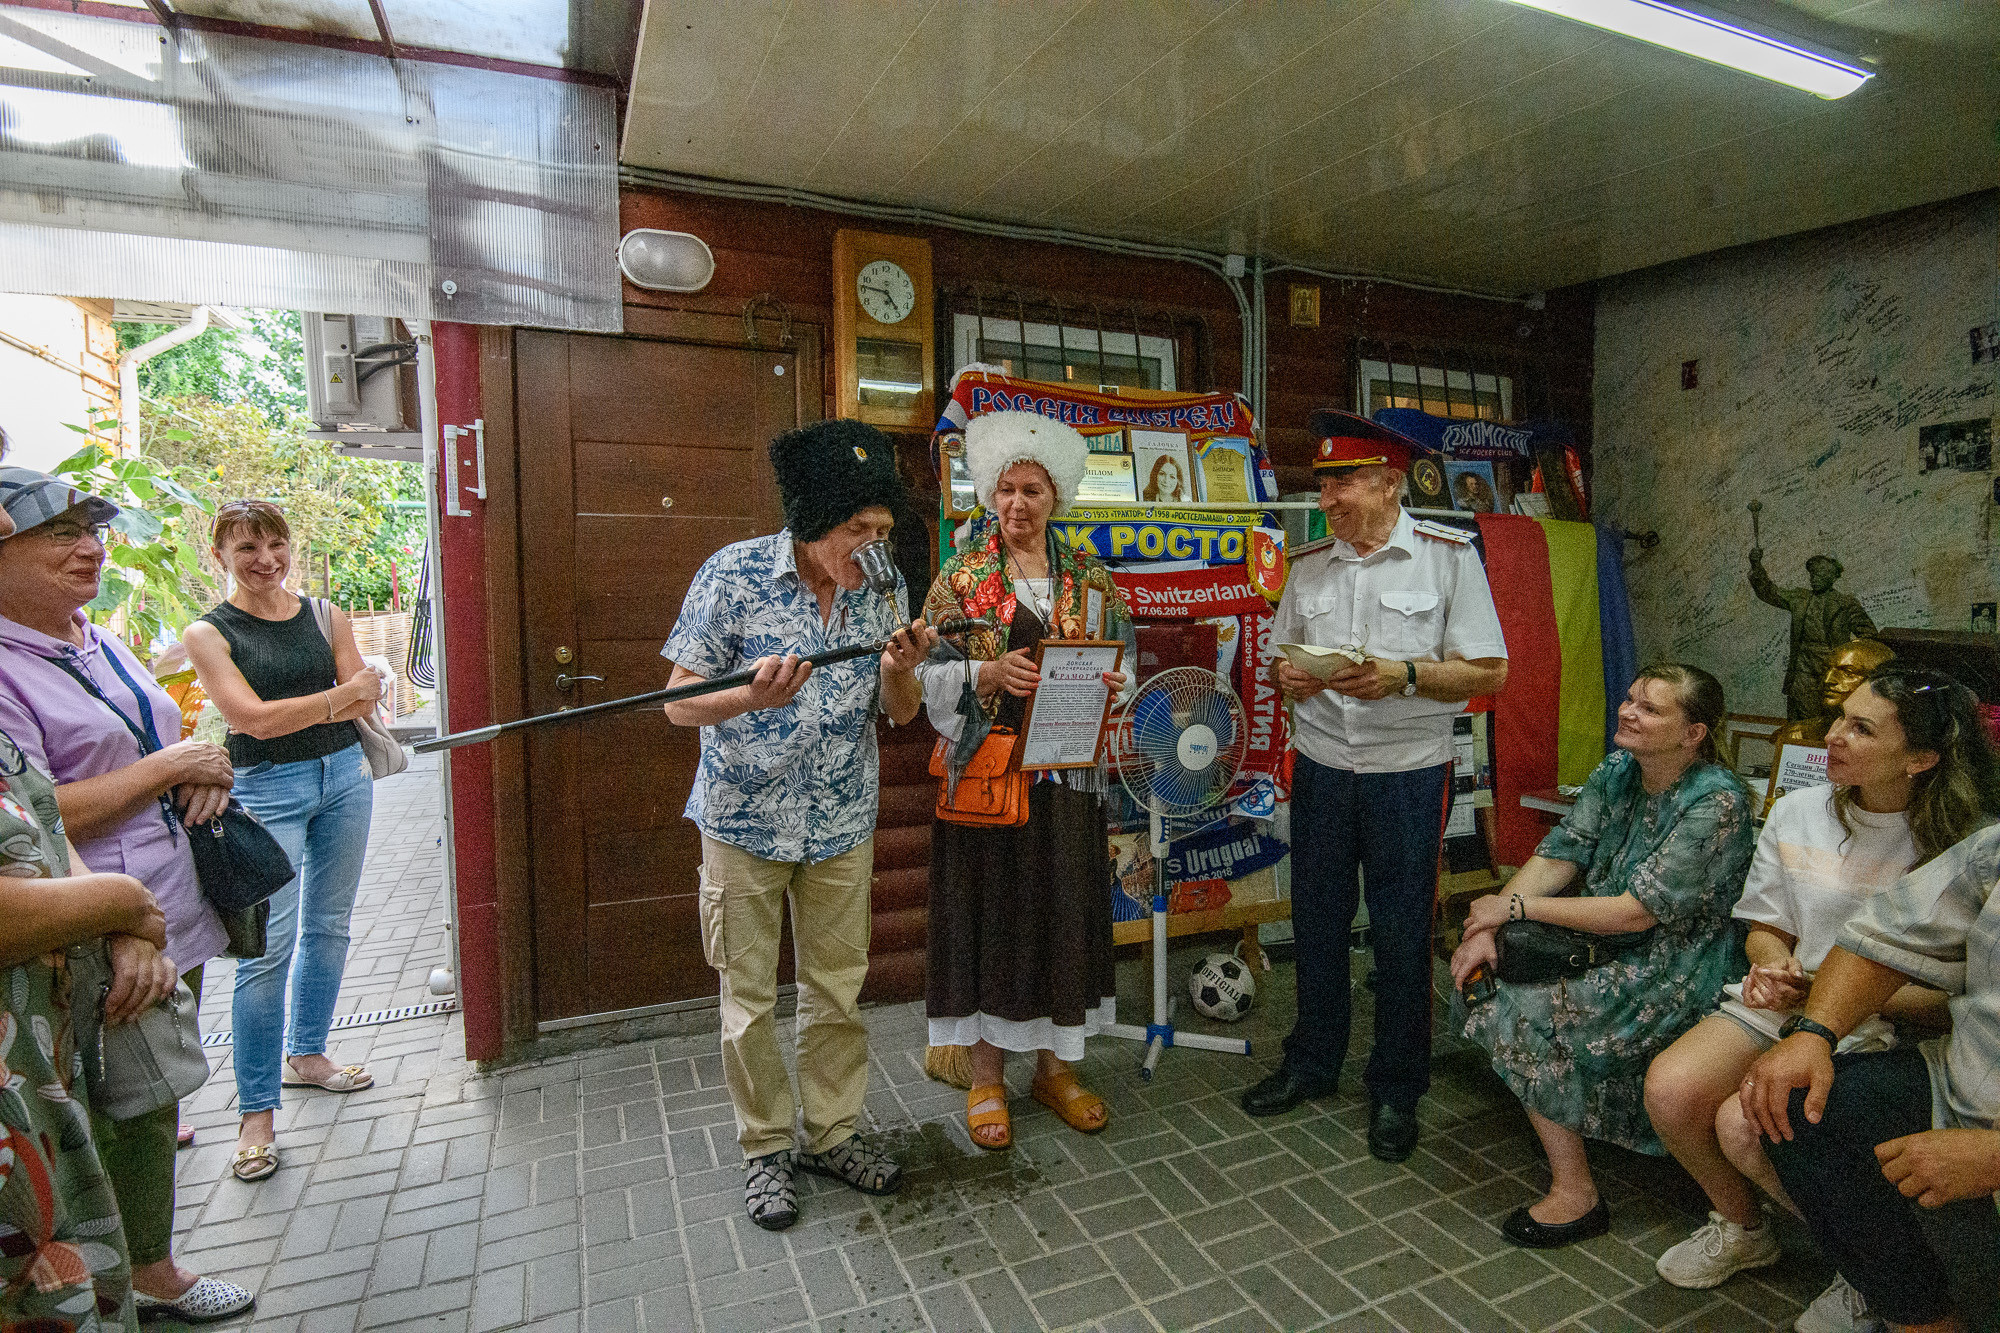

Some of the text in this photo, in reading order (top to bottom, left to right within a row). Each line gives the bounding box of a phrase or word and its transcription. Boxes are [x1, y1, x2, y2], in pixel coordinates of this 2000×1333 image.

[882, 265, 890, 273] 12
[863, 276, 871, 284] 10
[906, 291, 912, 299] 3
[864, 297, 870, 305] 8
[902, 302, 909, 310] 4
[872, 308, 878, 316] 7
[884, 312, 890, 320] 6
[971, 387, 1104, 425] РОССИЯ
[1084, 434, 1121, 452] БЕДА
[1093, 510, 1109, 519] 1953
[1111, 509, 1144, 519] «ТРАКТОР»
[1154, 510, 1170, 518] 1958
[1236, 515, 1251, 523] 2003
[1138, 606, 1189, 616] 17.06.2018
[1243, 614, 1252, 668] 6.06.2018
[1248, 614, 1275, 752] ХОРВАТИЯ
[1185, 866, 1233, 882] 20062018
[1202, 966, 1240, 999] OFFICIAL
